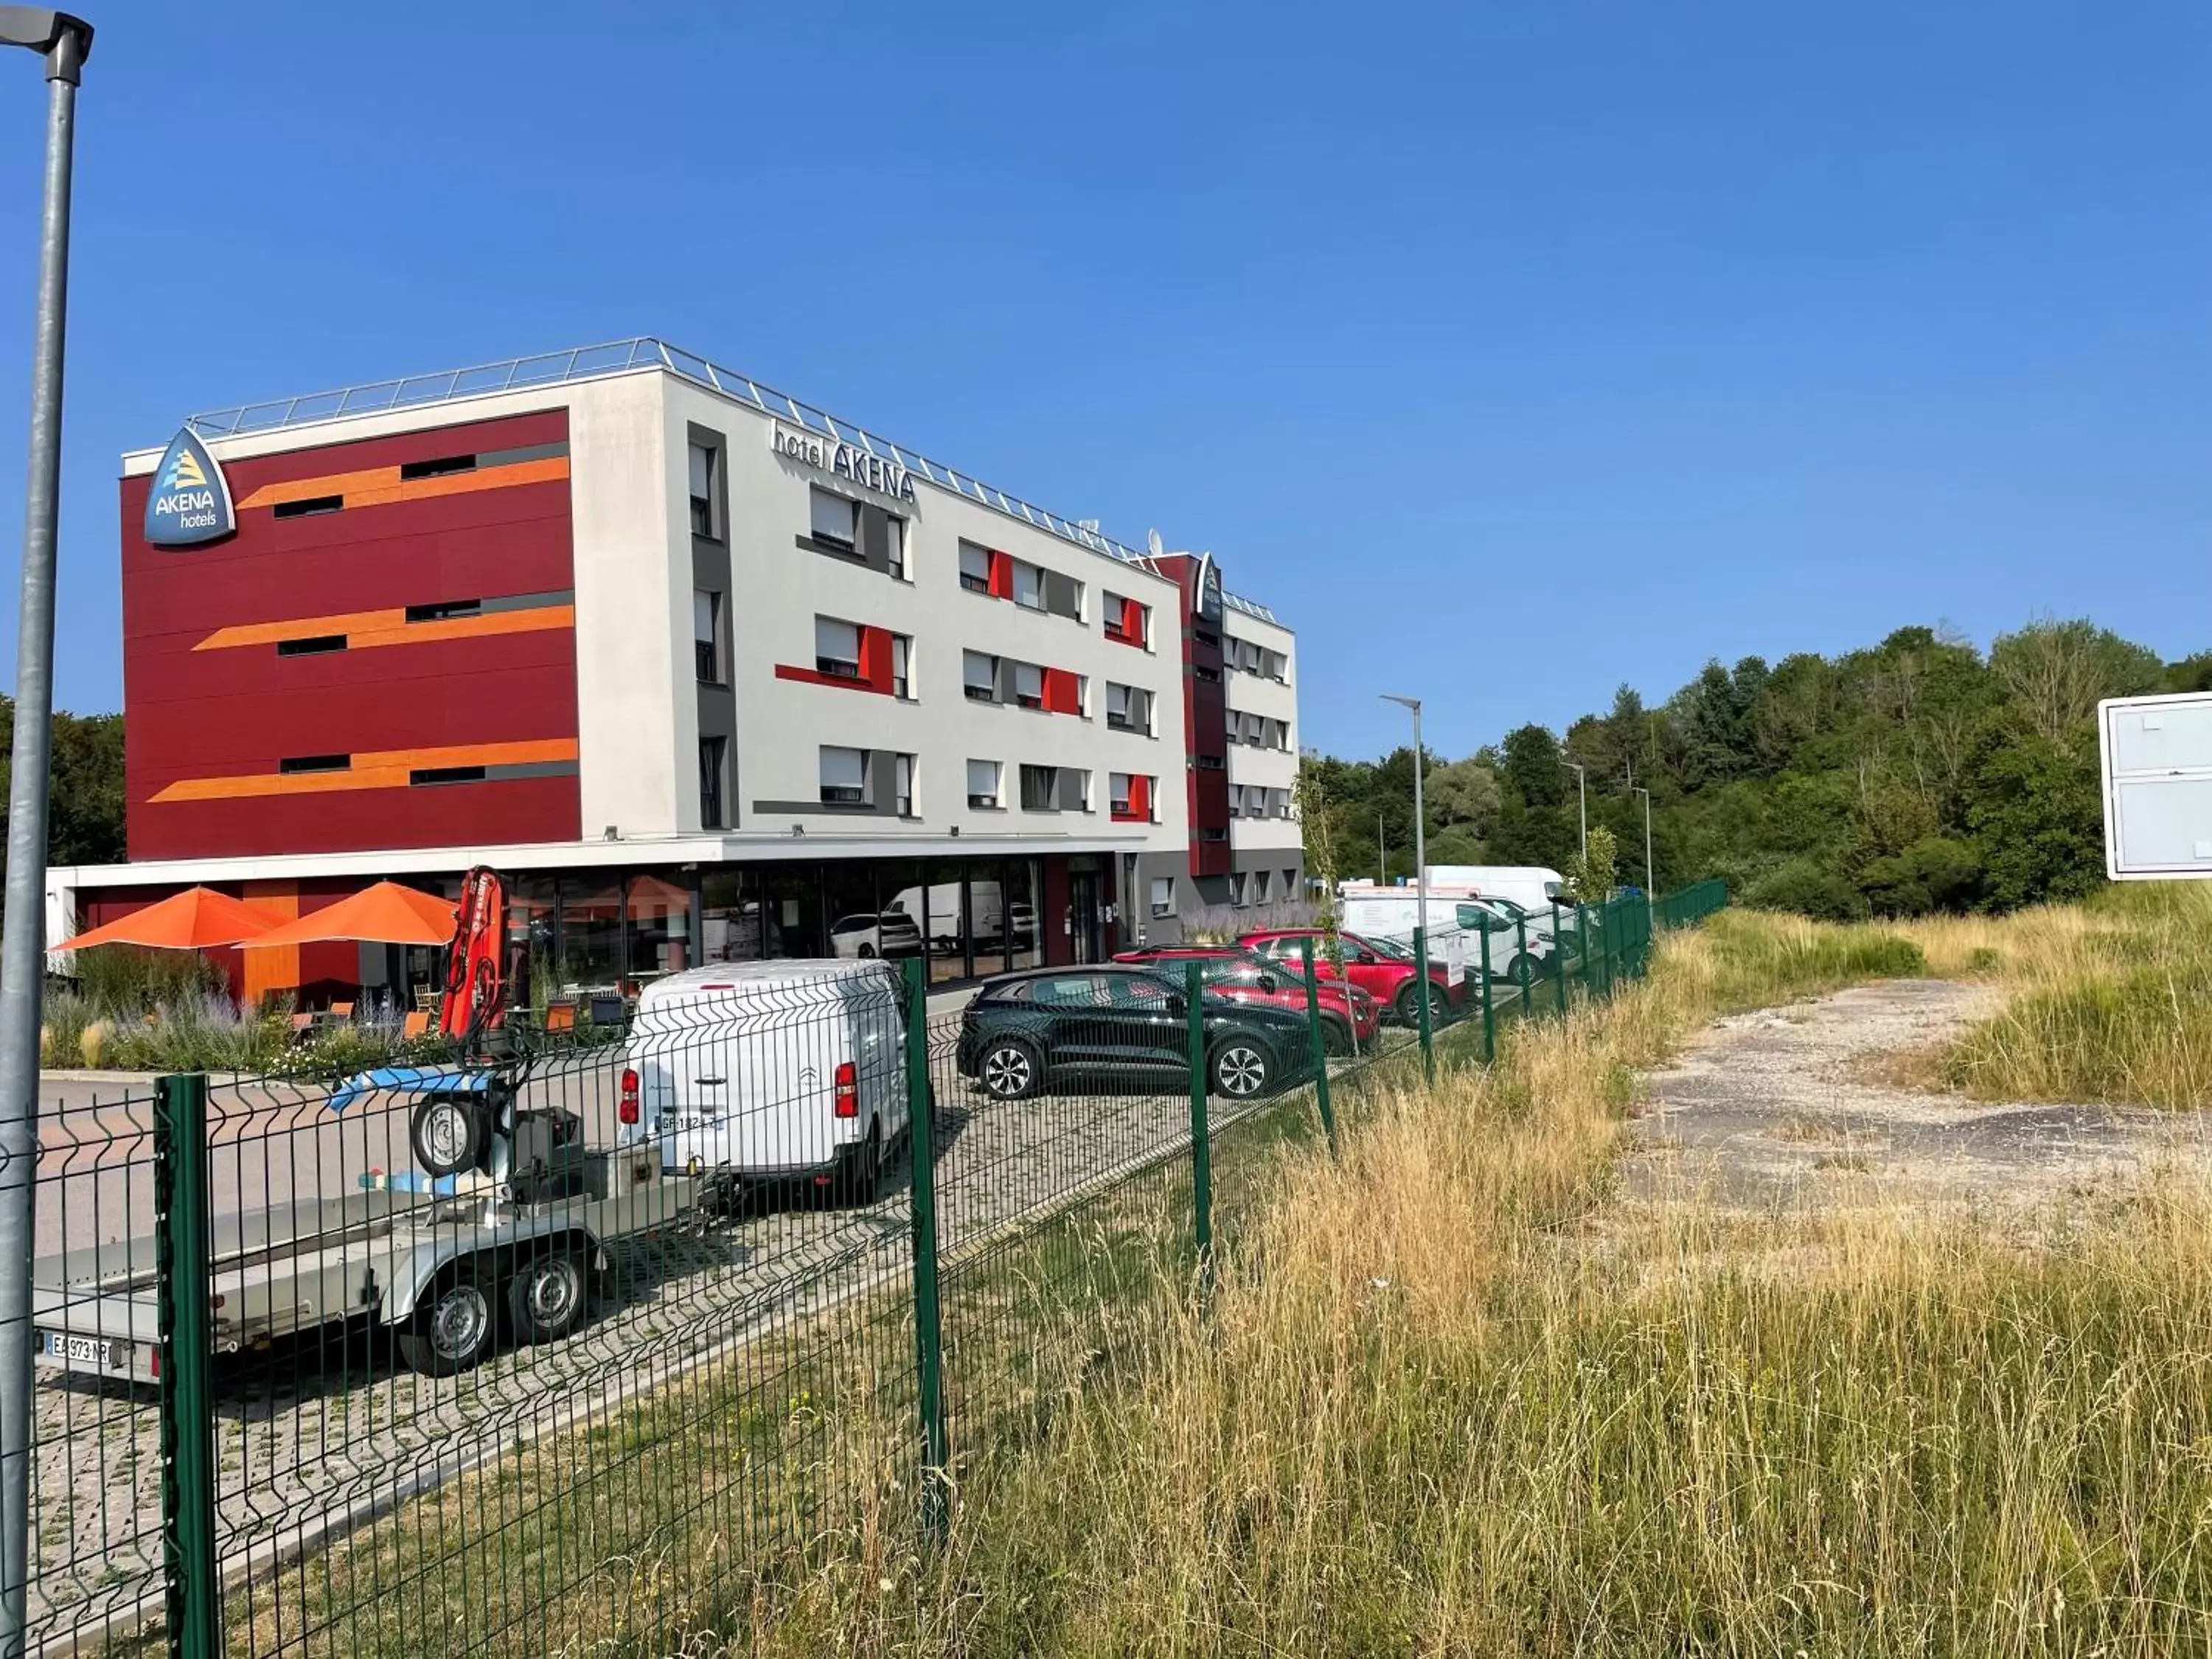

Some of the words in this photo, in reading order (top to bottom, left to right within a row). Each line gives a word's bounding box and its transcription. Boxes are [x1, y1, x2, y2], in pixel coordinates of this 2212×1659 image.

[771, 418, 824, 468] hotel
[830, 442, 915, 504] AKENA
[156, 490, 215, 515] AKENA
[180, 509, 216, 528] hotels
